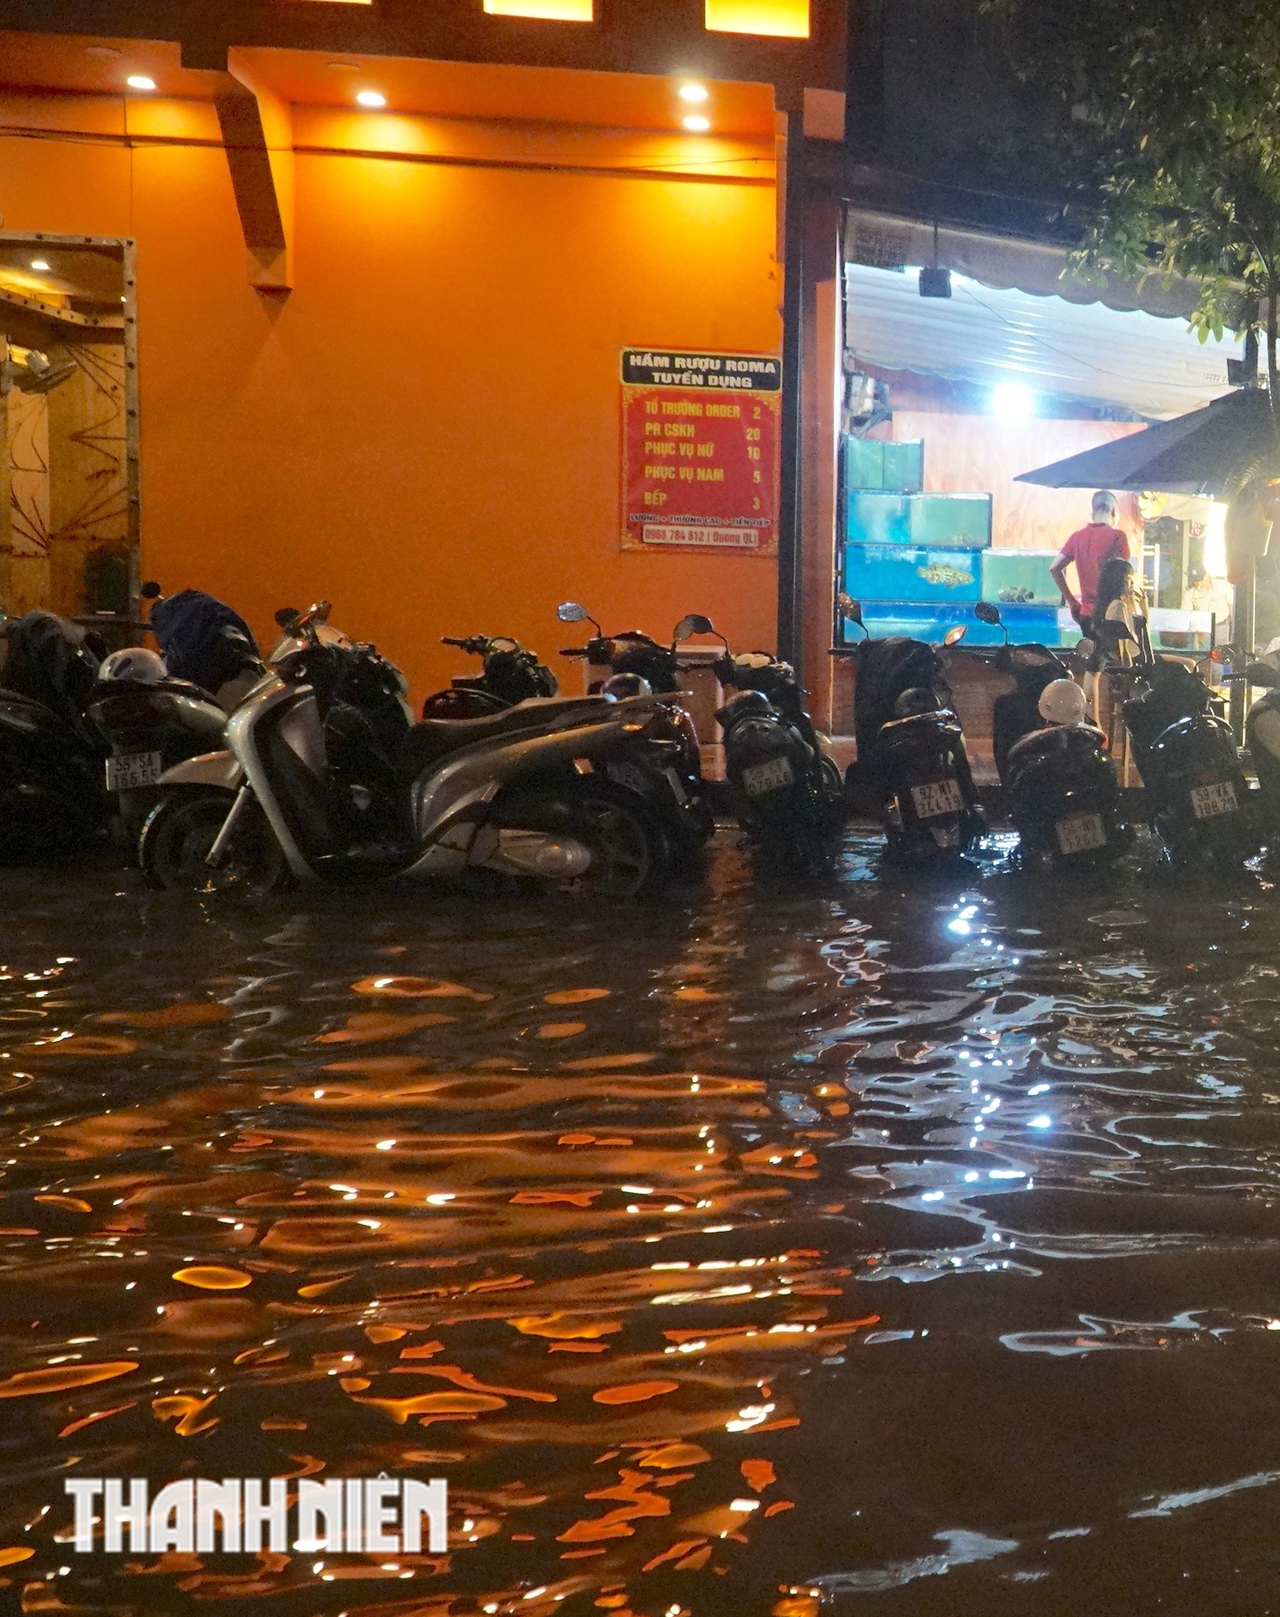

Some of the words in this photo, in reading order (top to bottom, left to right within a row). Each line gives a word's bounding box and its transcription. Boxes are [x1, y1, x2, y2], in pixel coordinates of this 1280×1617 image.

[725, 360, 776, 374] ROMA
[708, 375, 752, 389] DỤNG
[705, 404, 740, 418] ORDER
[753, 406, 761, 419] 2
[645, 422, 660, 436] PR
[664, 423, 695, 437] CSKH
[746, 427, 760, 441] 20
[645, 442, 676, 458] PHỤC
[679, 443, 694, 459] VỤ
[644, 465, 676, 482] PHỤC
[679, 466, 694, 483] VỤ
[697, 468, 724, 481] NAM
[753, 470, 760, 484] 5
[753, 497, 760, 510] 3
